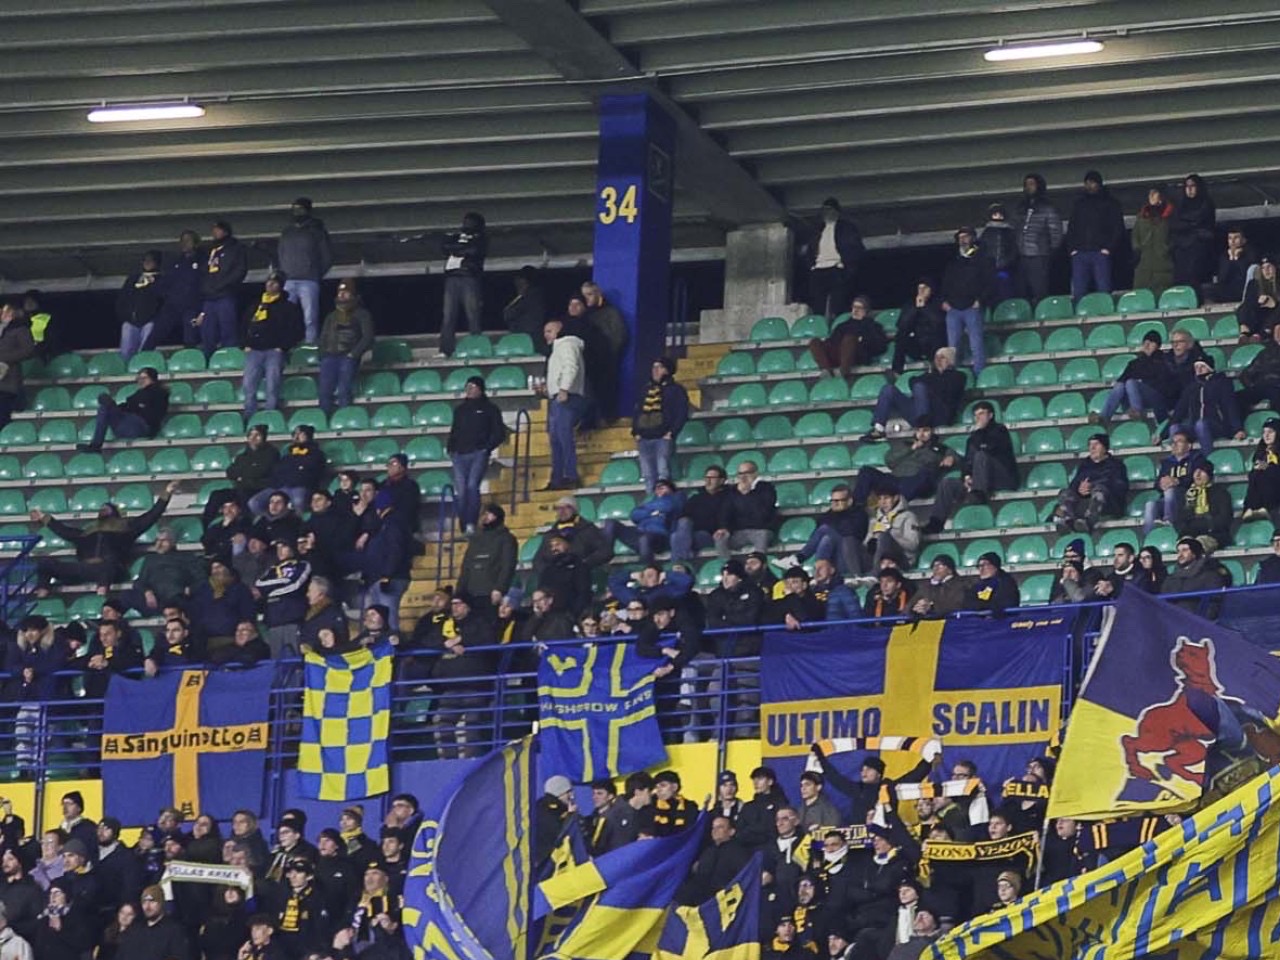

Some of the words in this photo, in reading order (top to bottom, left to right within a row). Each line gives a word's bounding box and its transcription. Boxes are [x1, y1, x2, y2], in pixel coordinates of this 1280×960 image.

[599, 184, 638, 225] 34
[767, 705, 882, 747] ULTIMO
[931, 697, 1050, 738] SCALIN
